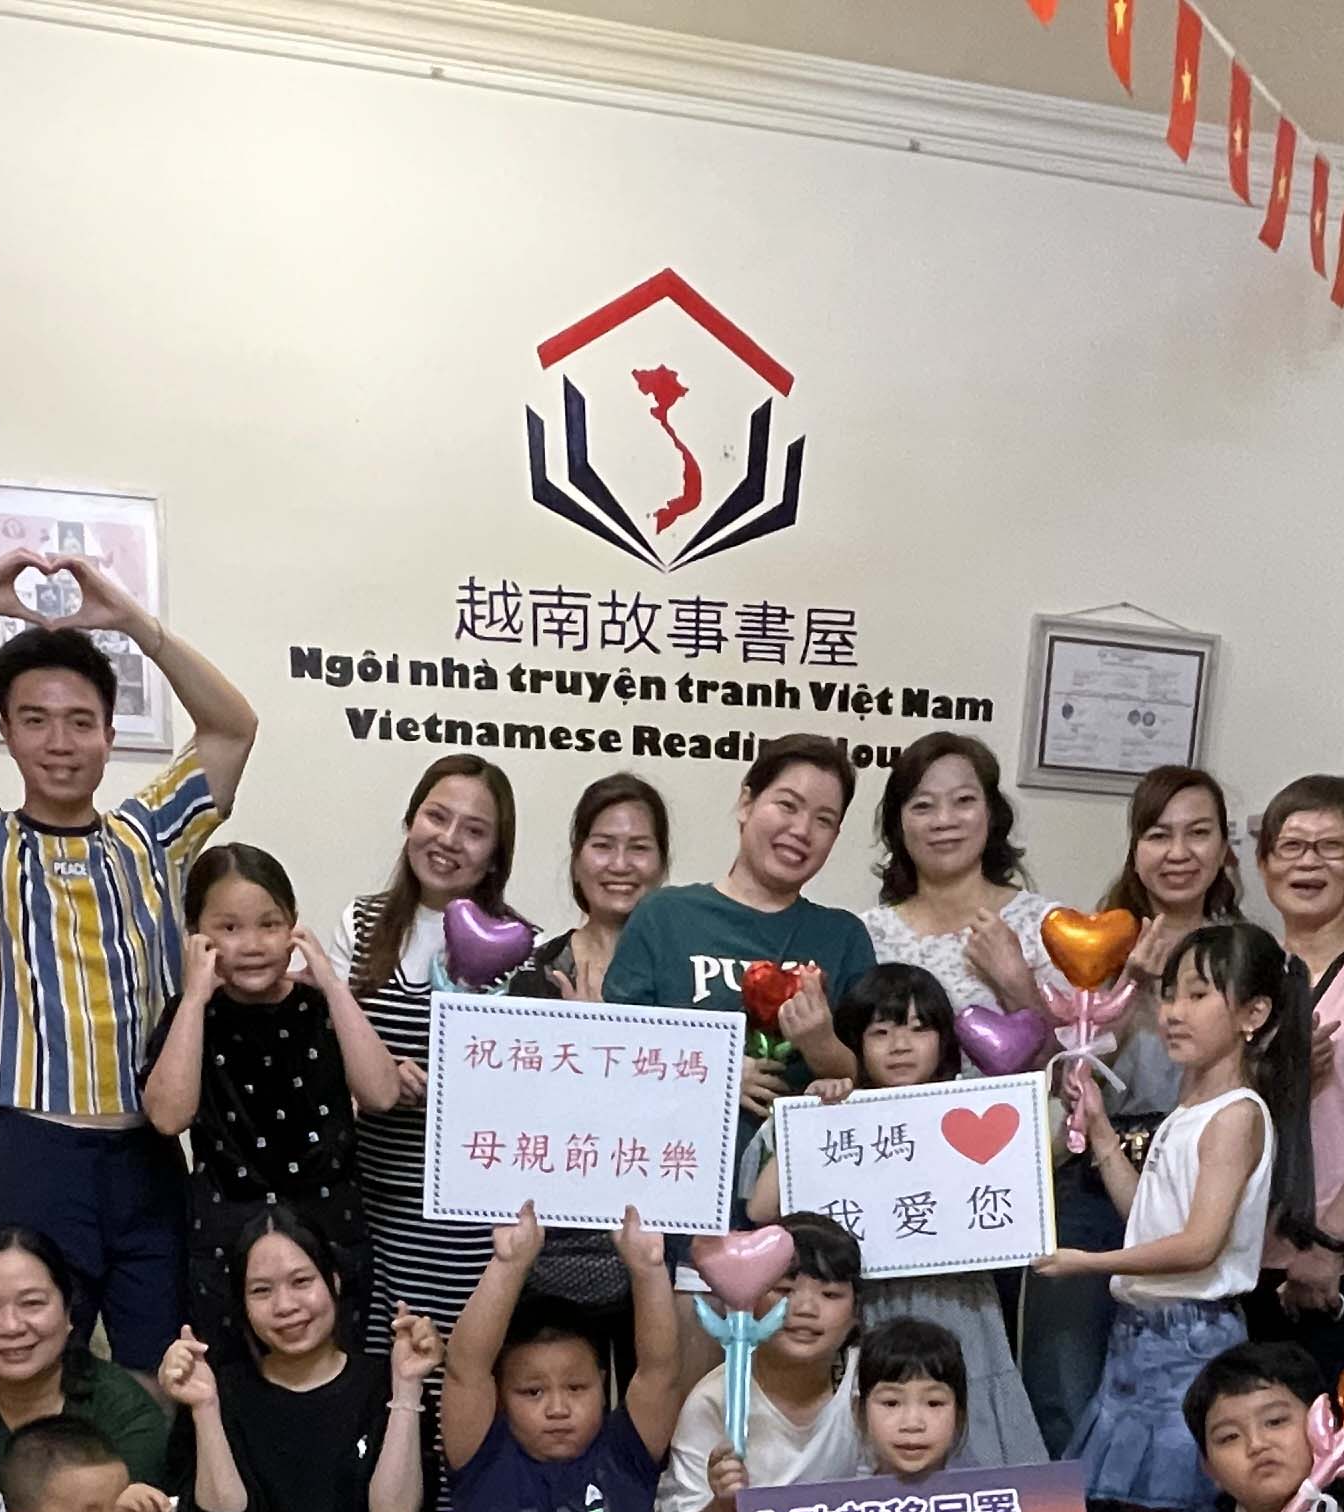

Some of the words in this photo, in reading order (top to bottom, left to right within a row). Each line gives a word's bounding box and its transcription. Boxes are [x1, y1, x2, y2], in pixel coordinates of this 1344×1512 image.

[455, 575, 858, 667] 越南故事書屋
[289, 645, 400, 687] Ngôi
[409, 657, 498, 690] nhà
[507, 662, 667, 705] truyện
[675, 672, 801, 709] tranh
[809, 681, 894, 721] Việt
[902, 687, 994, 722] Nam
[345, 707, 623, 752] Vietnamese
[464, 1035, 709, 1084] 祝福天下媽媽
[461, 1130, 699, 1183] 母親節快樂
[819, 1122, 916, 1168] 媽媽
[819, 1184, 1014, 1242] 我愛您
